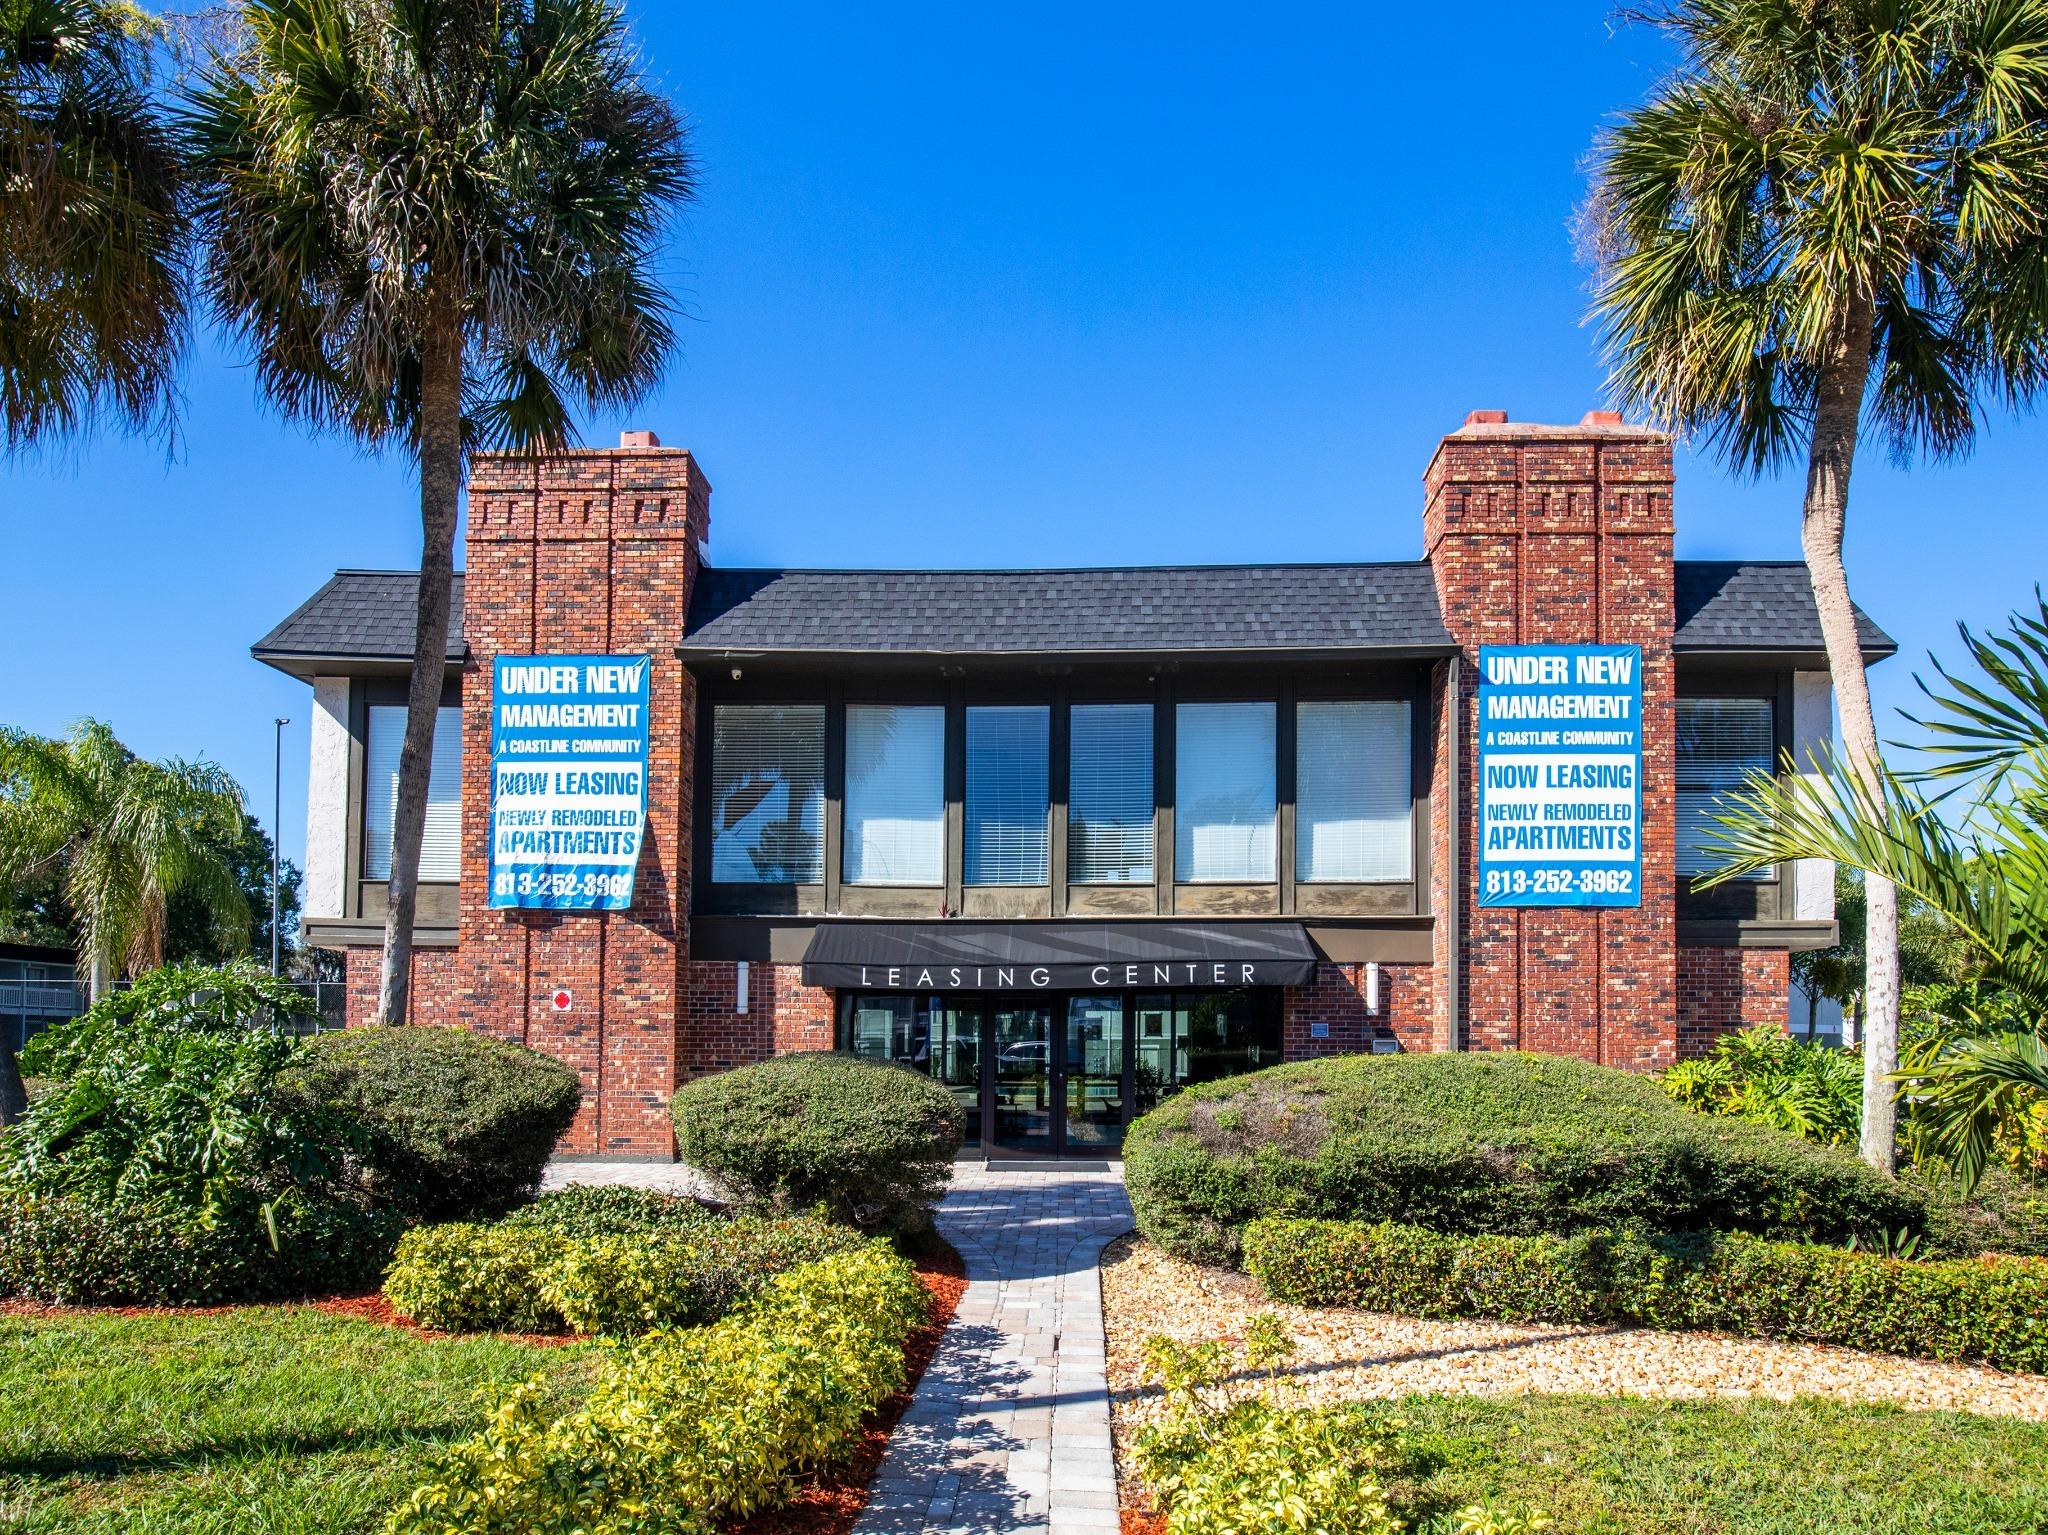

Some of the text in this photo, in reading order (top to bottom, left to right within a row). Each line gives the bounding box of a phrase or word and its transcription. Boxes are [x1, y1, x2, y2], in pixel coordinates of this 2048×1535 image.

[501, 666, 641, 694] UNDER NEW
[1488, 656, 1633, 684] UNDER NEW
[501, 705, 640, 728] MANAGEMENT
[1488, 696, 1631, 719] MANAGEMENT
[499, 740, 641, 753] A COASTLINE COMMUNITY
[1486, 731, 1633, 745] A COASTLINE COMMUNITY
[500, 772, 638, 796] NOW LEASING
[1488, 765, 1631, 789] NOW LEASING
[499, 810, 637, 827] NEWLY REMODELED
[1488, 804, 1631, 820] NEWLY REMODELED
[499, 831, 636, 854] APARTMENTS
[1488, 826, 1631, 850] APARTMENTS
[496, 873, 631, 896] 813-252-3962
[1486, 870, 1632, 893] 813-252-3962
[862, 964, 1254, 986] LEASING CENTER
